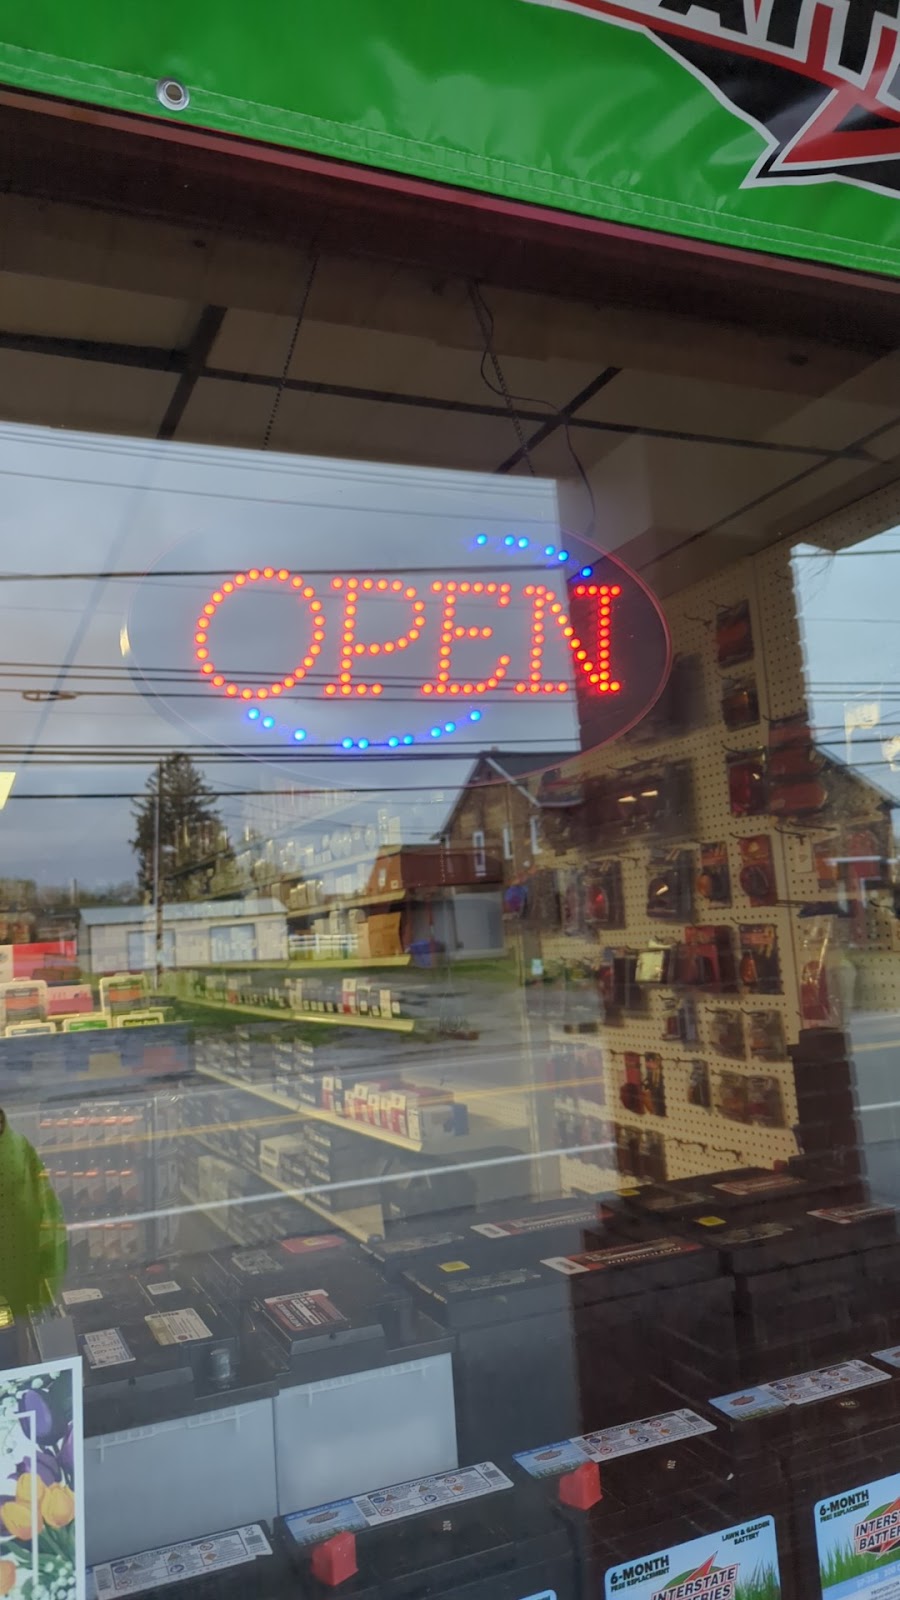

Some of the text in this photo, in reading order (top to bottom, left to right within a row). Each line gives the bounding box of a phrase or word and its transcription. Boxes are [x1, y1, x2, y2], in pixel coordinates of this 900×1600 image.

[196, 567, 621, 699] OPEN
[820, 1489, 869, 1516] 6-MONTH
[721, 1530, 740, 1542] LAWN
[746, 1519, 770, 1533] GARDEN
[855, 1511, 900, 1537] INTERS
[734, 1530, 760, 1545] BATTERY
[610, 1554, 670, 1585] 6-MONTH
